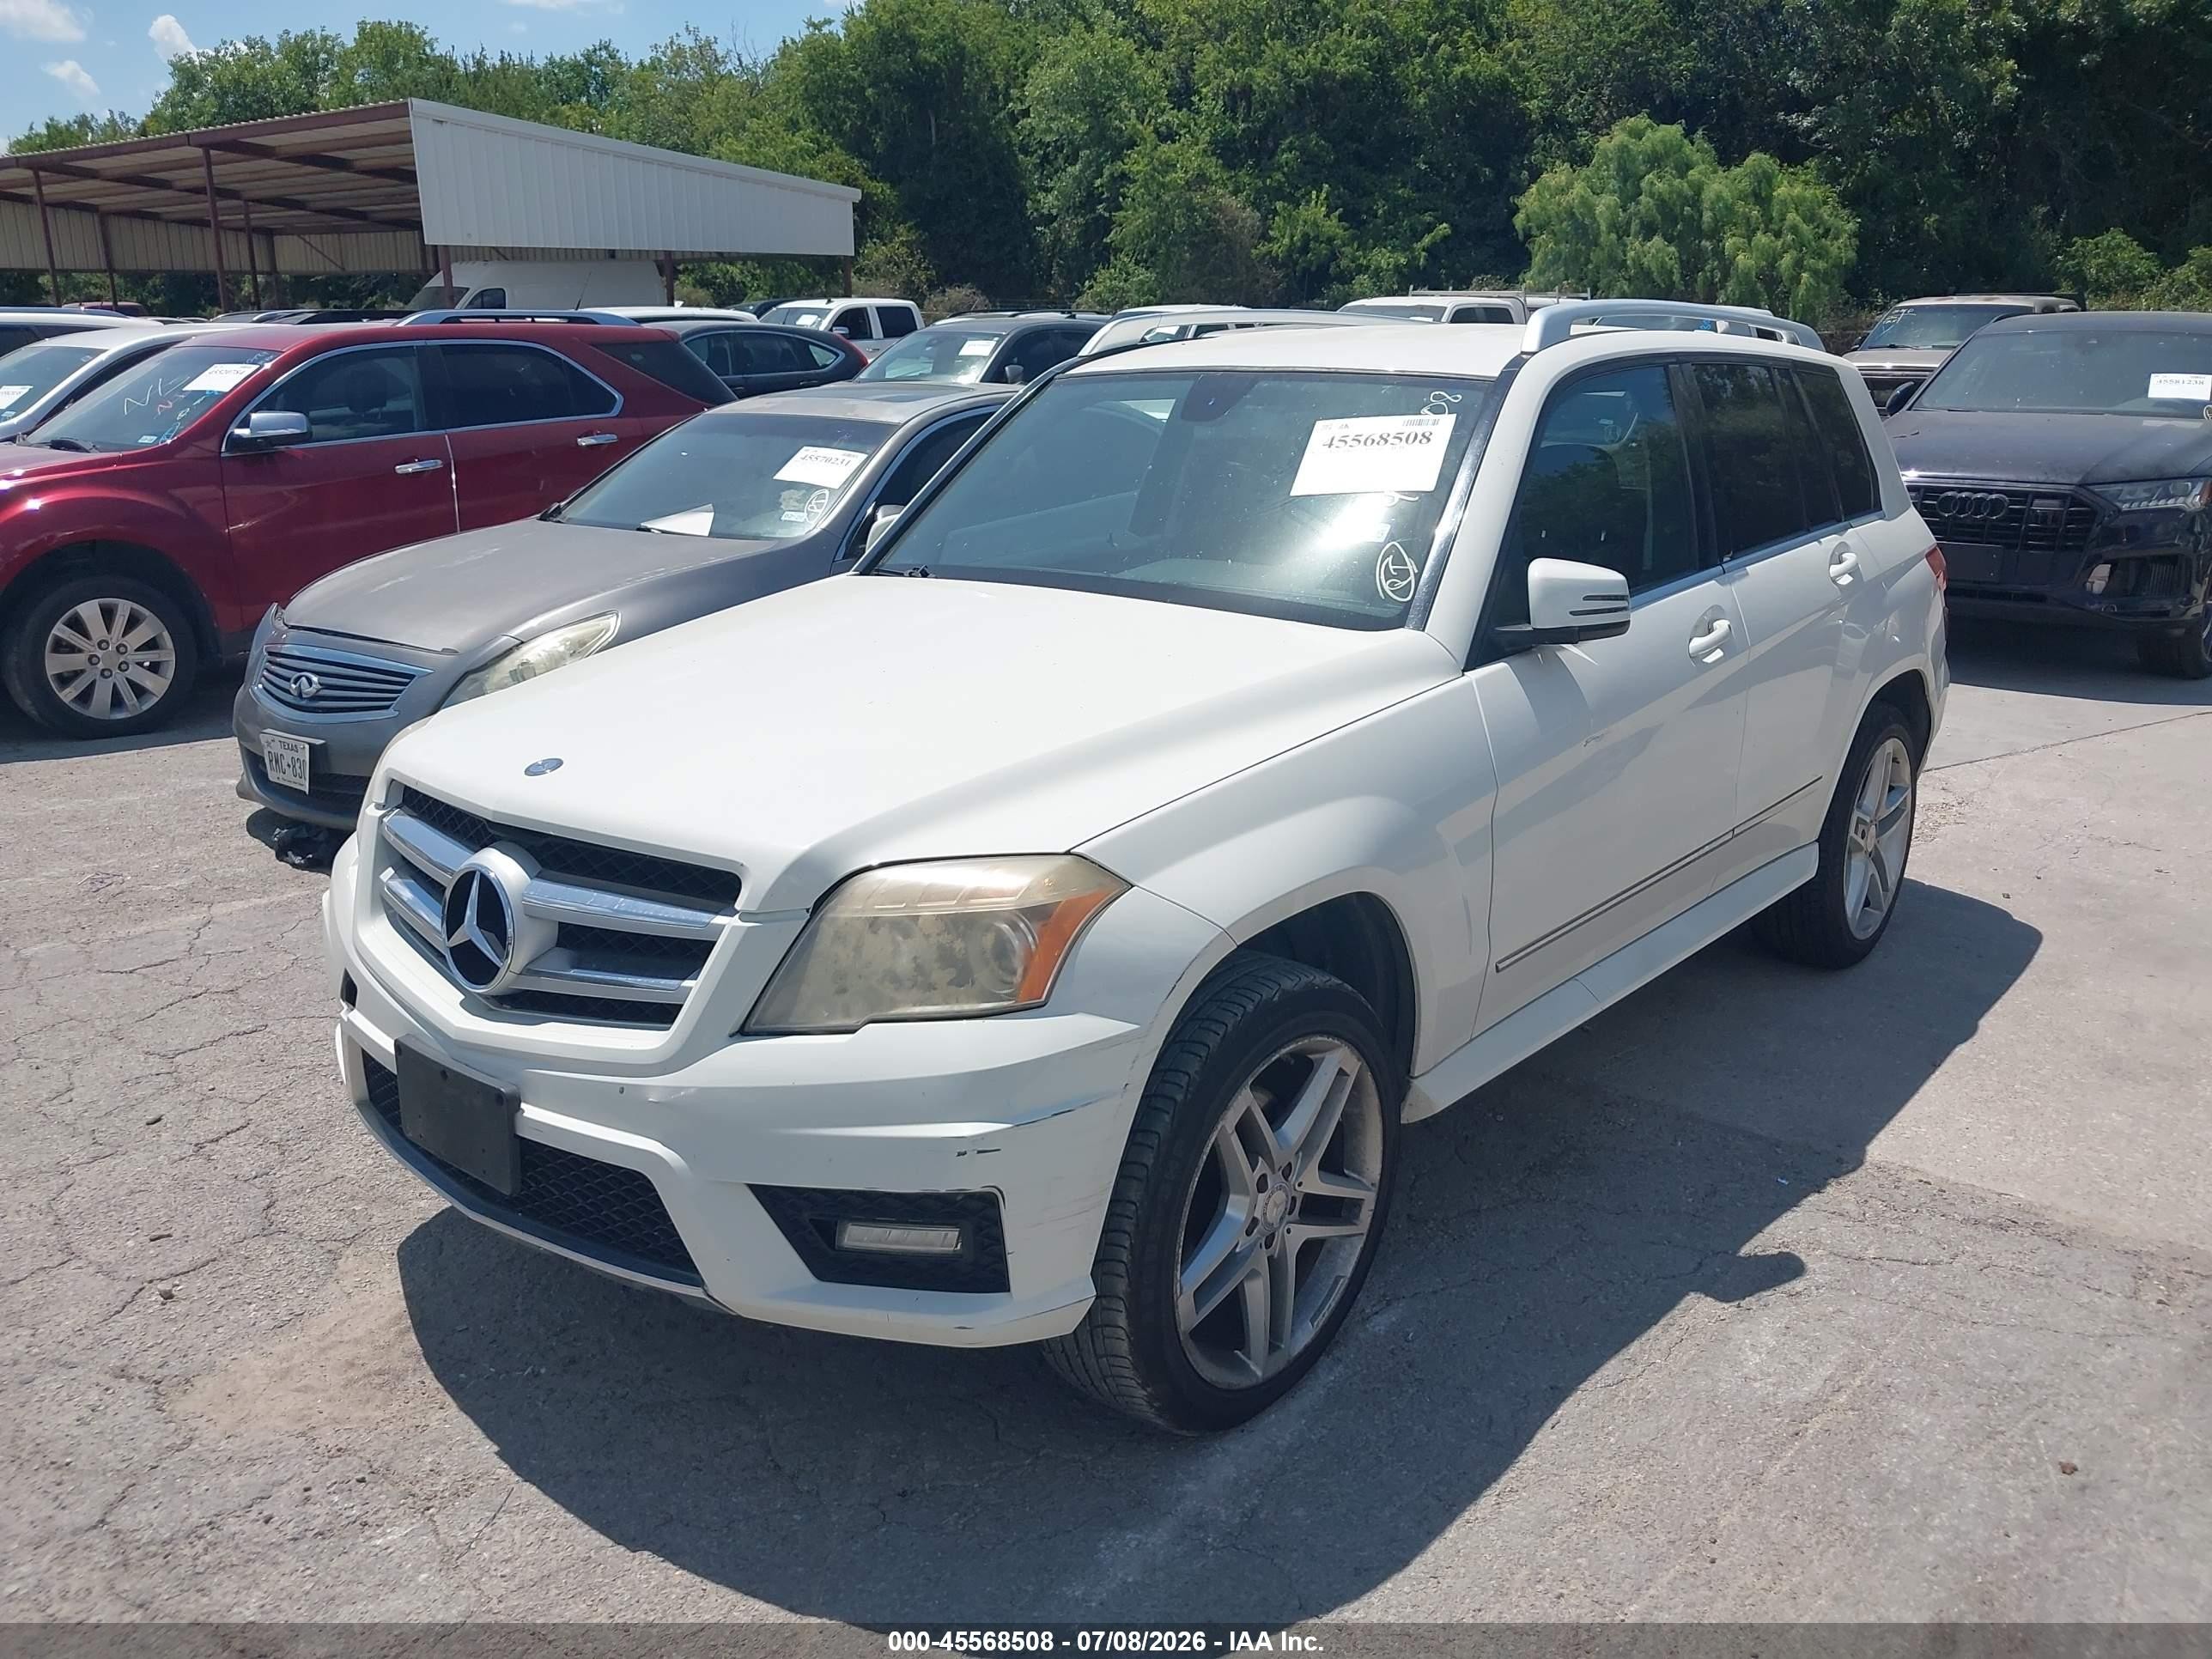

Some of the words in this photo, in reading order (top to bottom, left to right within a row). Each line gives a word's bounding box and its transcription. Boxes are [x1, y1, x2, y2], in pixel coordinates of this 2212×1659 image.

[1322, 430, 1433, 448] 45568508
[800, 453, 852, 467] 45570231
[278, 740, 299, 753] TEXAS
